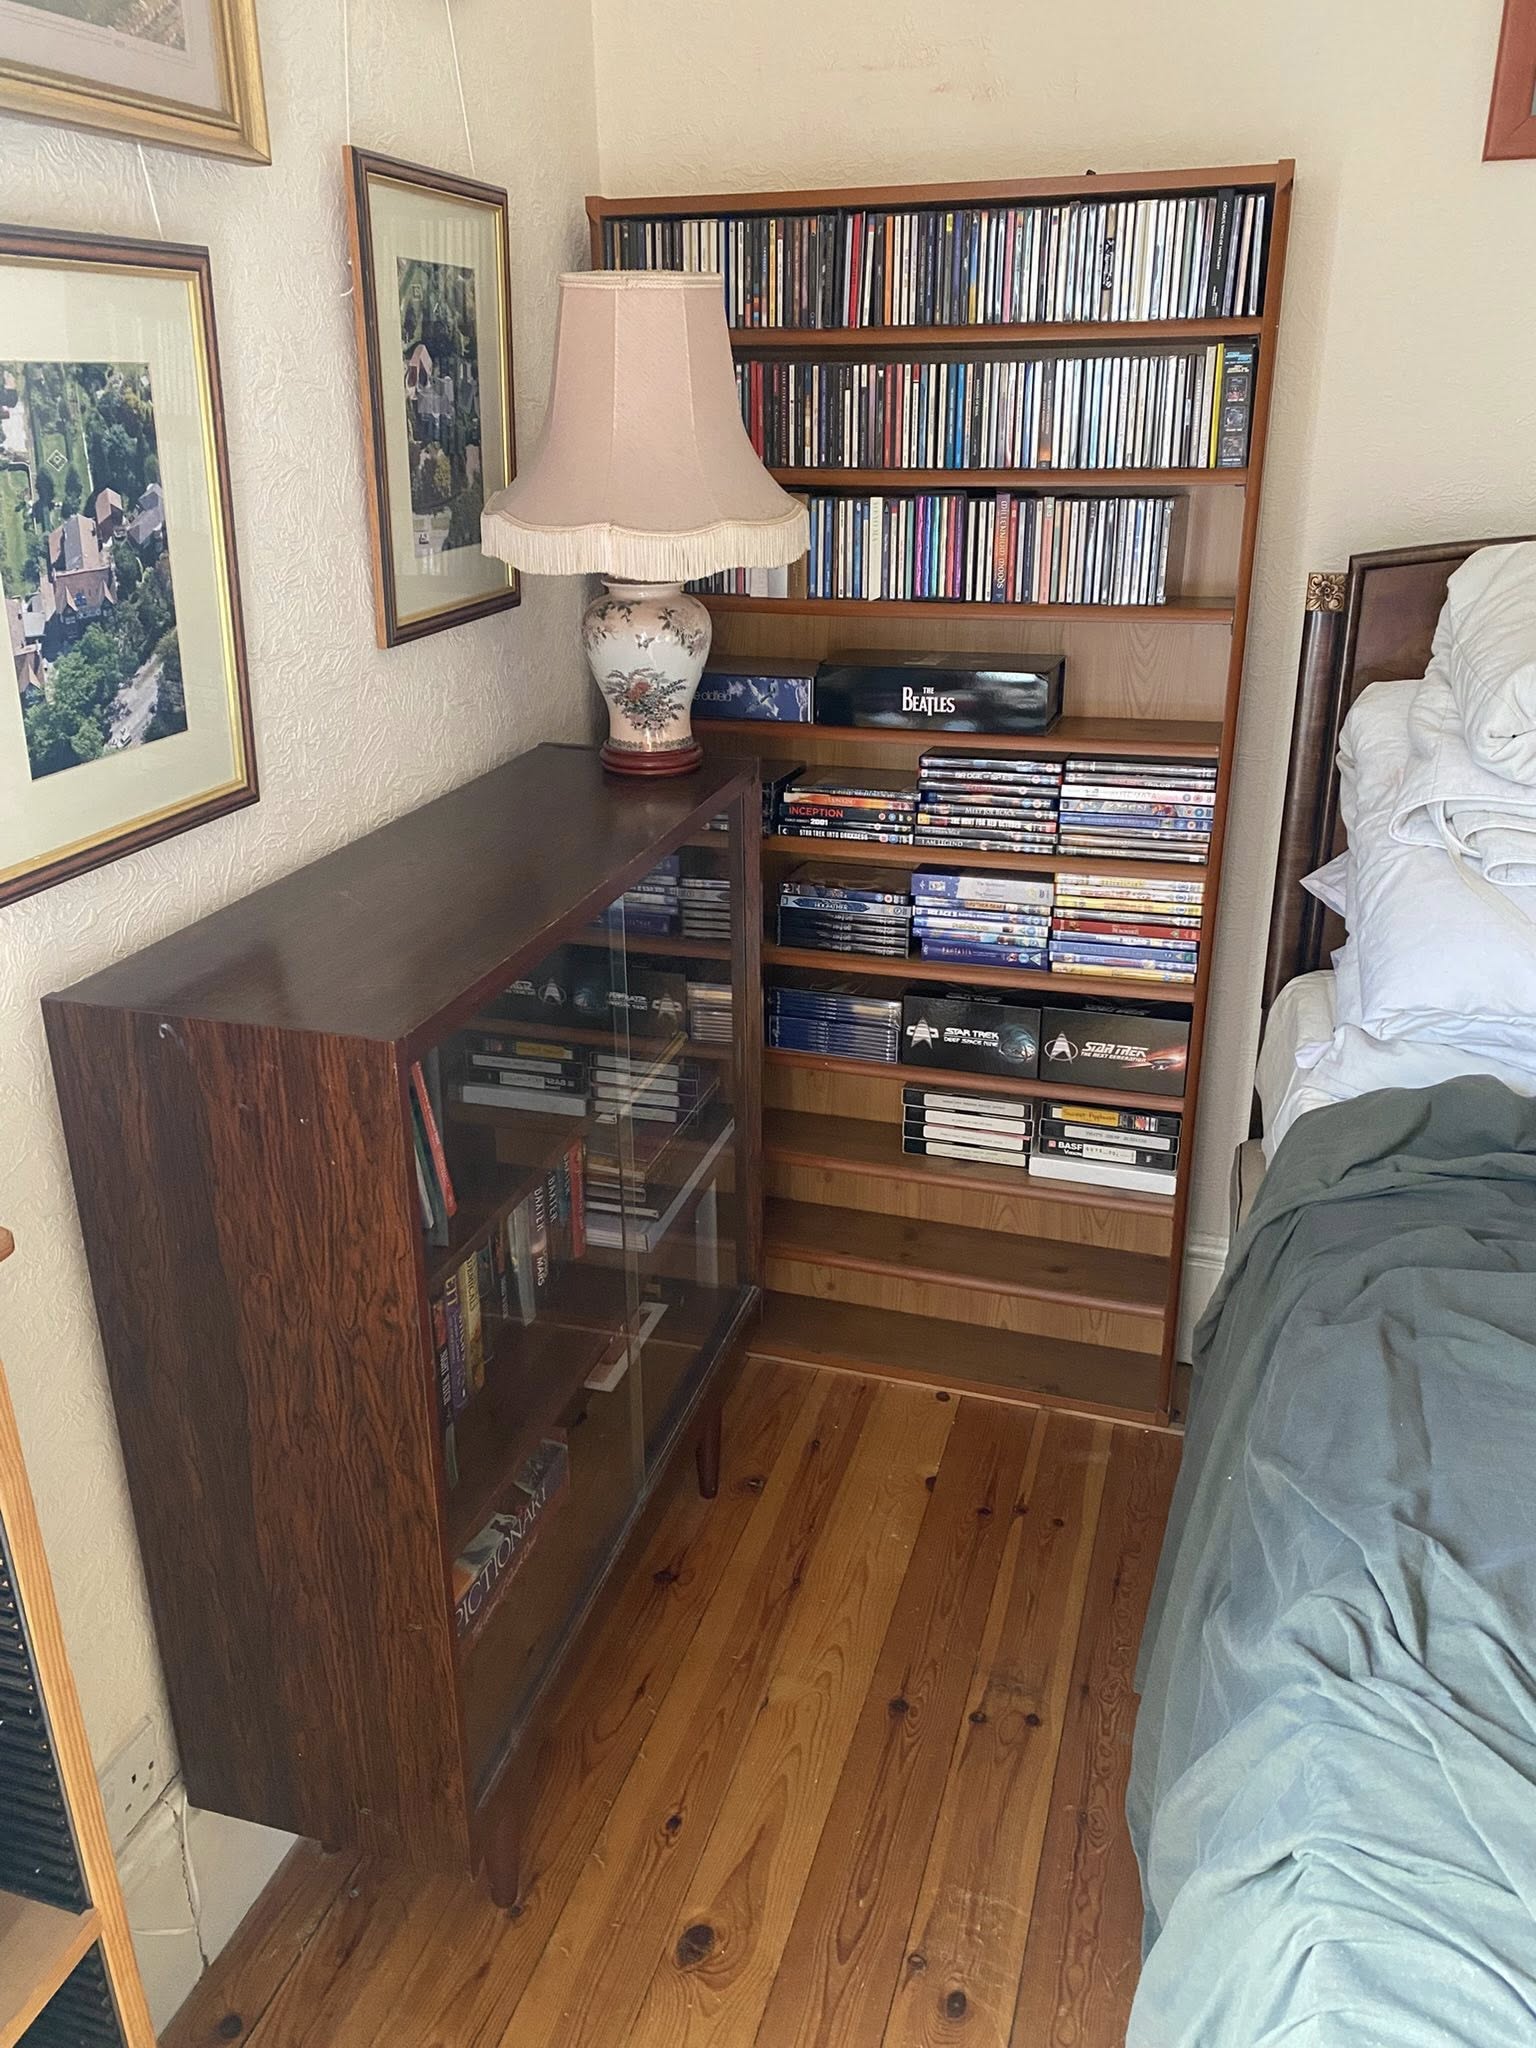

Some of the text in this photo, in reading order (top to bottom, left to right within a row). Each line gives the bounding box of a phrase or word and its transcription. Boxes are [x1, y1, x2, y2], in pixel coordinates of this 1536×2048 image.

[922, 687, 935, 695] THE
[902, 686, 956, 716] BEATLES
[788, 806, 844, 818] INCEPTION
[809, 818, 828, 826] 2001
[799, 829, 812, 837] STAR
[944, 1027, 999, 1040] STAR TREK
[960, 1038, 982, 1046] SPACE
[1082, 1041, 1149, 1058] STAR TREK
[1058, 1141, 1083, 1151] BASF
[536, 1256, 546, 1286] MARS
